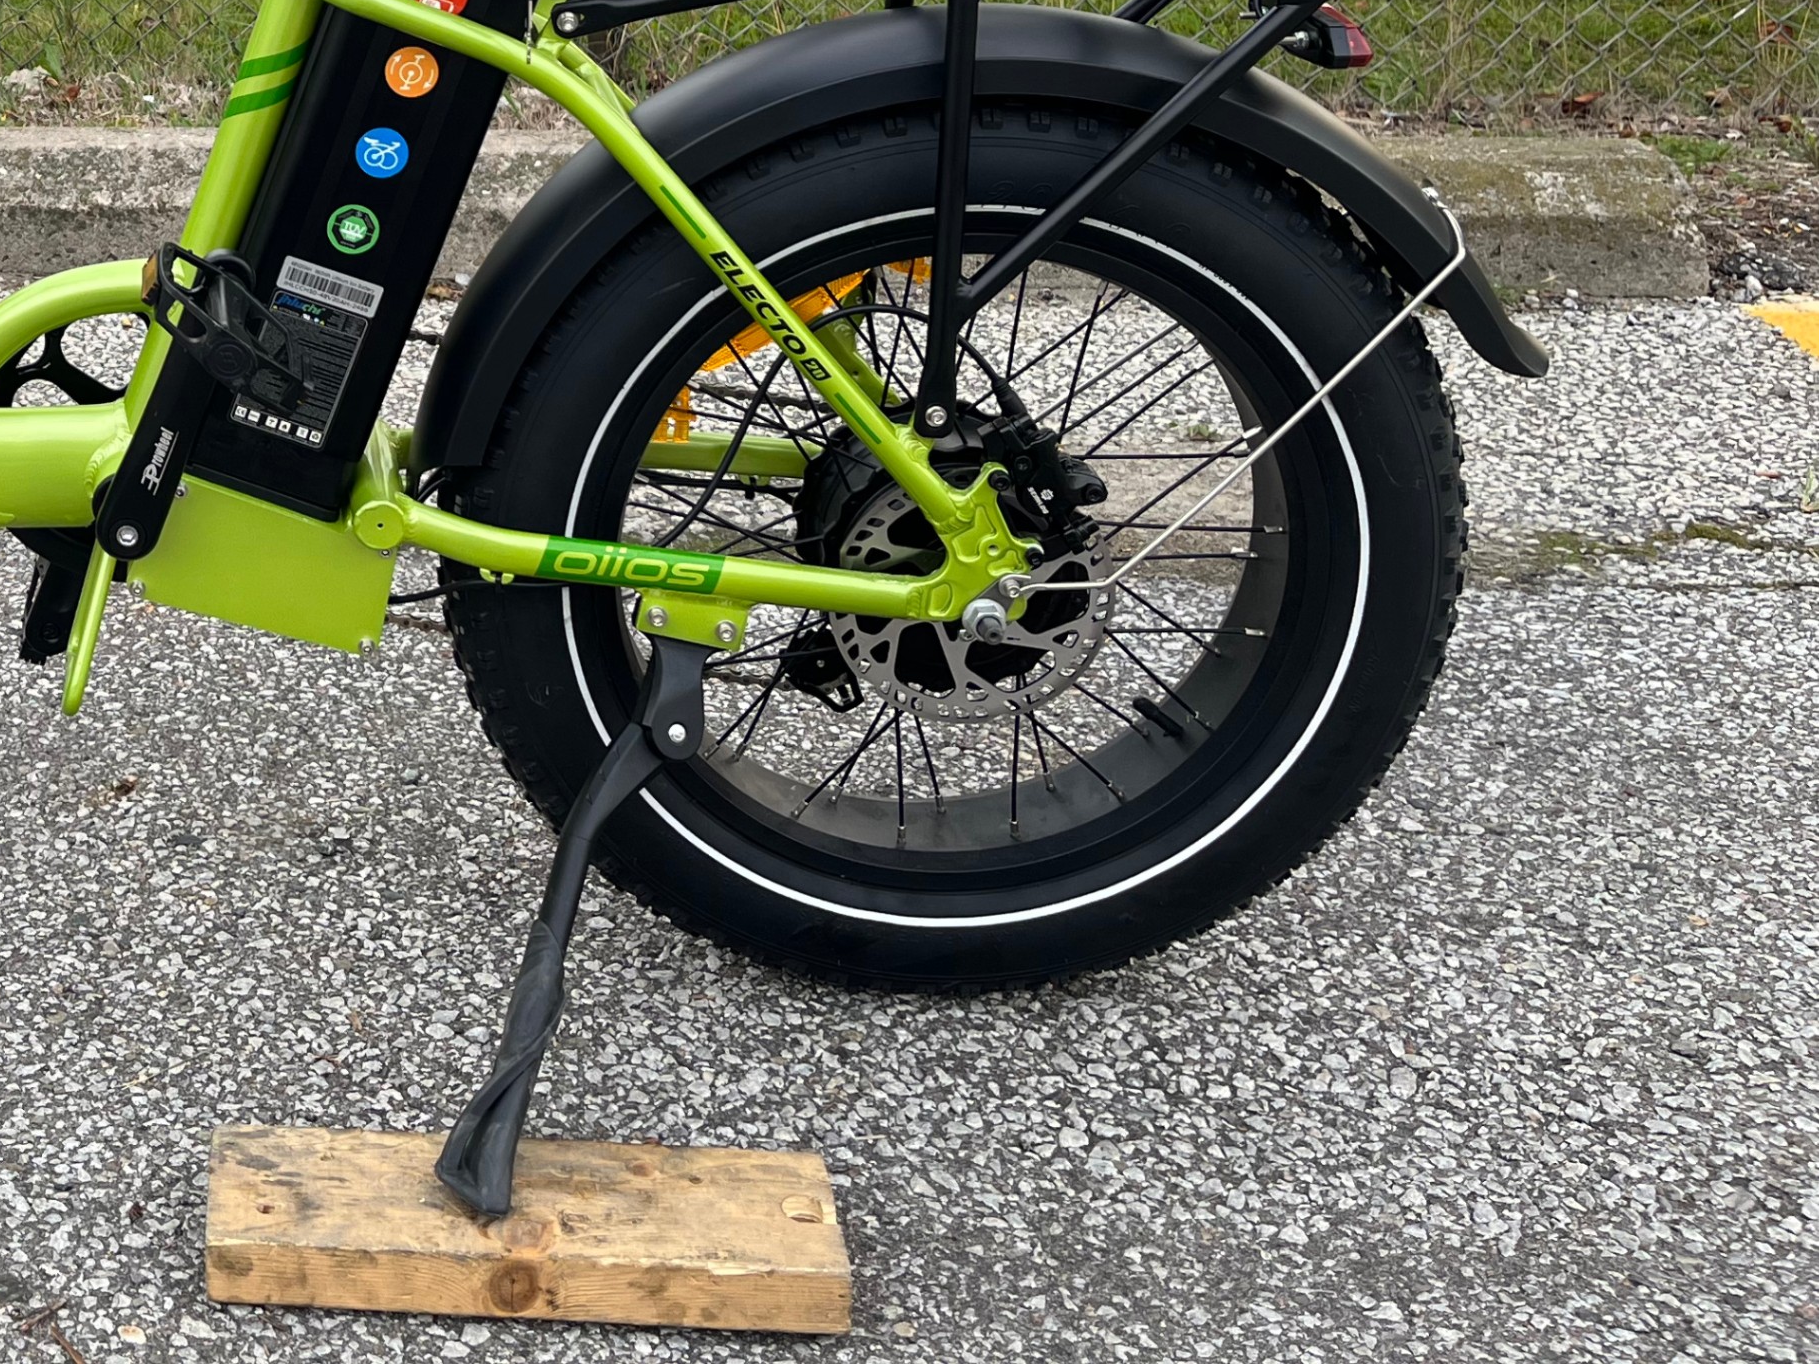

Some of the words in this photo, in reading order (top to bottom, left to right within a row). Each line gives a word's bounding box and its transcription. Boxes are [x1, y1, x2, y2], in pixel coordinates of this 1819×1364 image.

[709, 250, 807, 355] ELECTO
[141, 426, 177, 494] Prowheel
[553, 546, 710, 586] oiios
